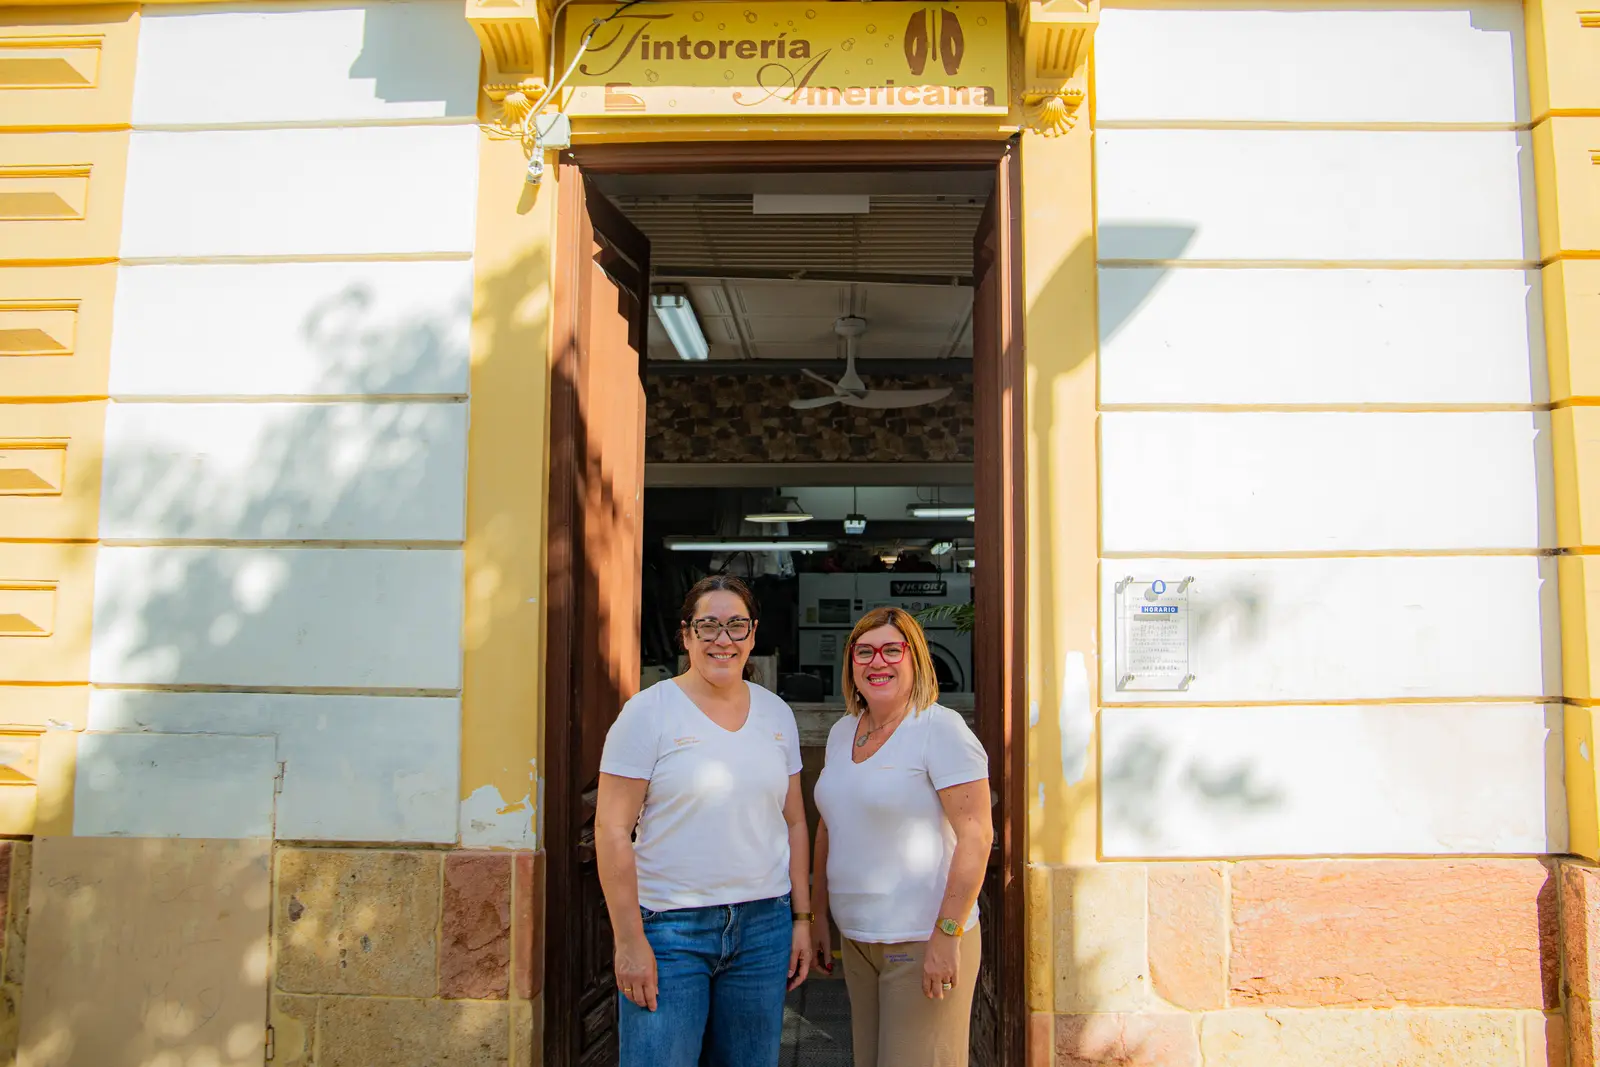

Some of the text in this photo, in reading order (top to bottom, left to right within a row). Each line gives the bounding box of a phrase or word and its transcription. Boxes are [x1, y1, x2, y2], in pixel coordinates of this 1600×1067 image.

[580, 13, 811, 76] Tintorería
[733, 48, 995, 107] Americana
[895, 583, 945, 594] VICTORY
